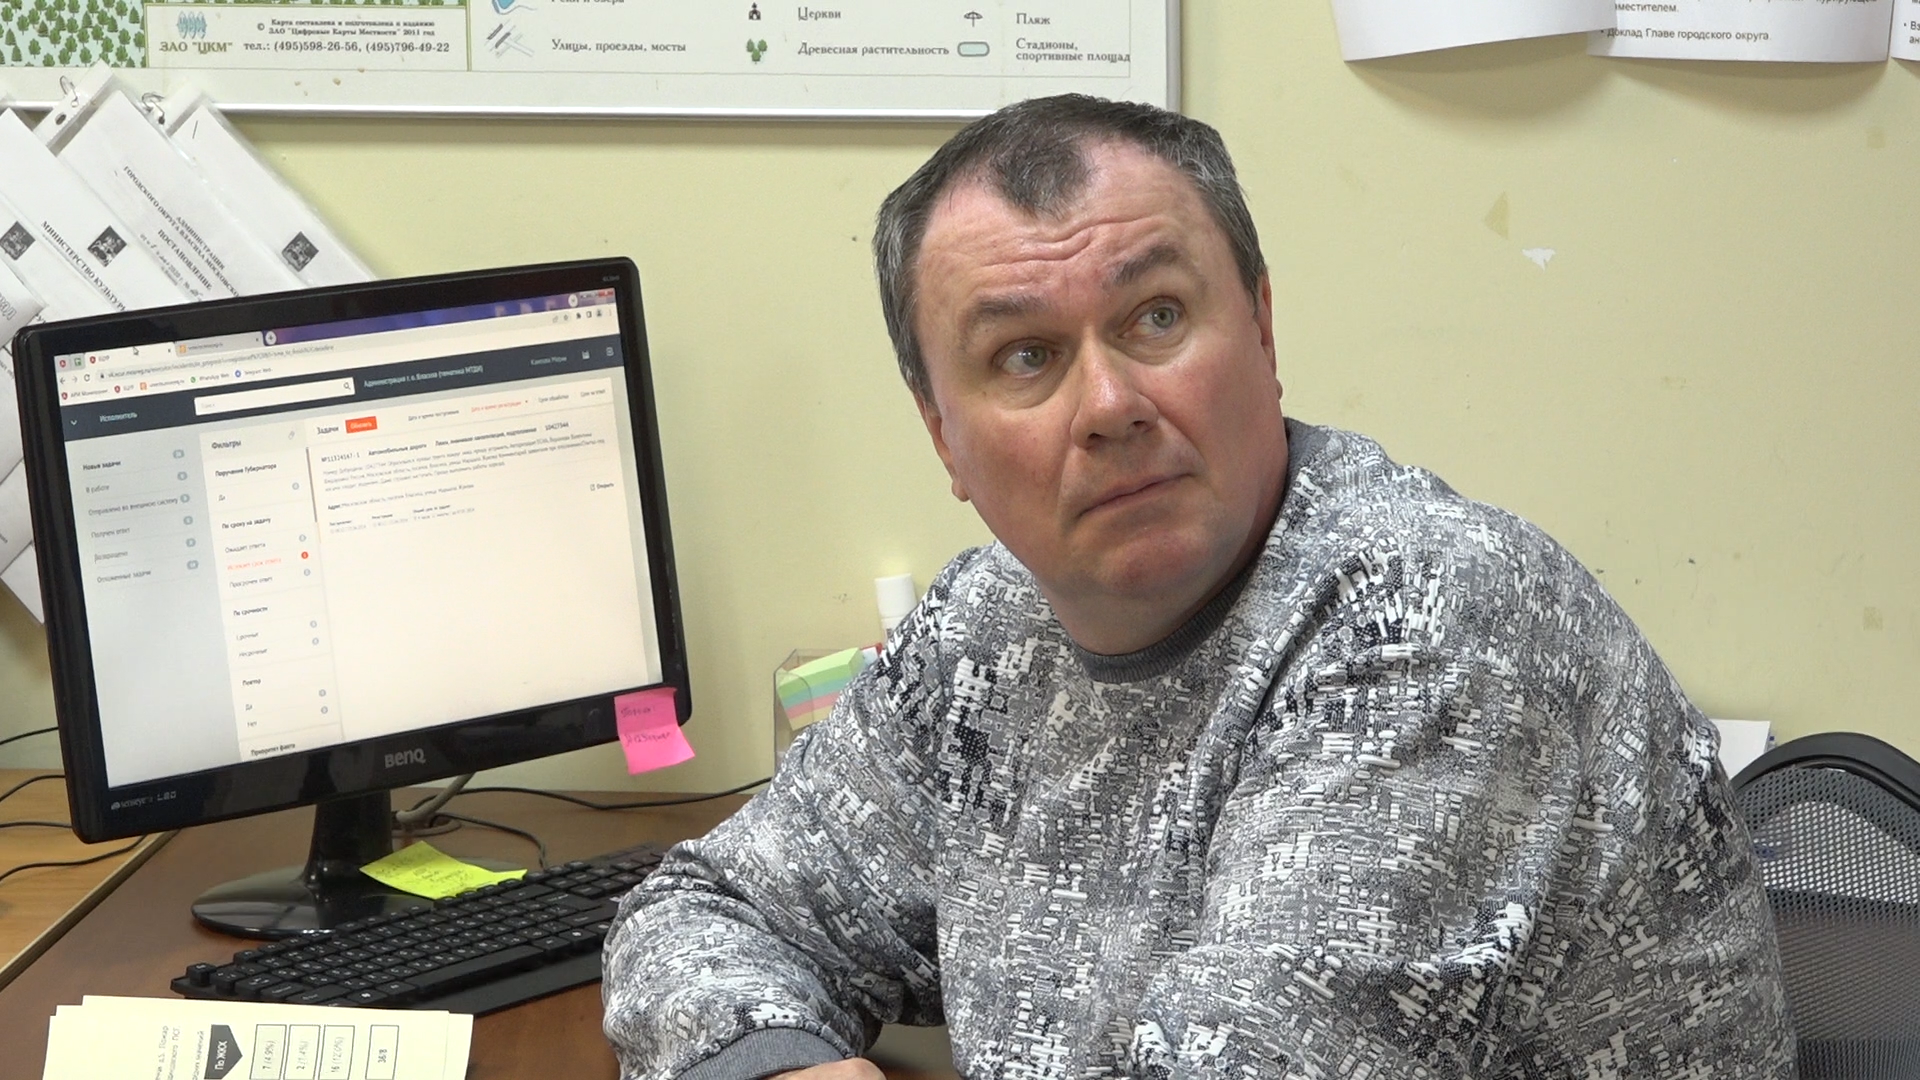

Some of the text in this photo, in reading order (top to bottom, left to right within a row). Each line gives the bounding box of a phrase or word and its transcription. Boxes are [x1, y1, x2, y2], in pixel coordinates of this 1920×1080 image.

[798, 7, 841, 21] Церкви
[1016, 13, 1051, 25] Пляж
[1607, 28, 1643, 38] Доклад
[1646, 28, 1675, 39] Главе
[1678, 30, 1731, 40] городского
[159, 41, 233, 54] ЗАО "ЦКМ"
[274, 41, 362, 53] (495)598-26-56,
[366, 42, 450, 53] (495)796-49-22
[551, 39, 687, 53] Улицы, проезды, мосты
[797, 42, 950, 56] Древесная растительность
[1016, 37, 1078, 51] Стадионы,
[1016, 52, 1131, 64] спортивные площад
[121, 166, 160, 208] ГОРОДСКОГО
[156, 205, 181, 231] ОКРУГА
[40, 219, 95, 280] МИНИСТЕРСТВО
[156, 228, 213, 291] ПОСТАНОВЛЕНИЕ
[211, 438, 241, 451] Фильтры
[384, 748, 426, 769] BenQ
[215, 1059, 225, 1070] По
